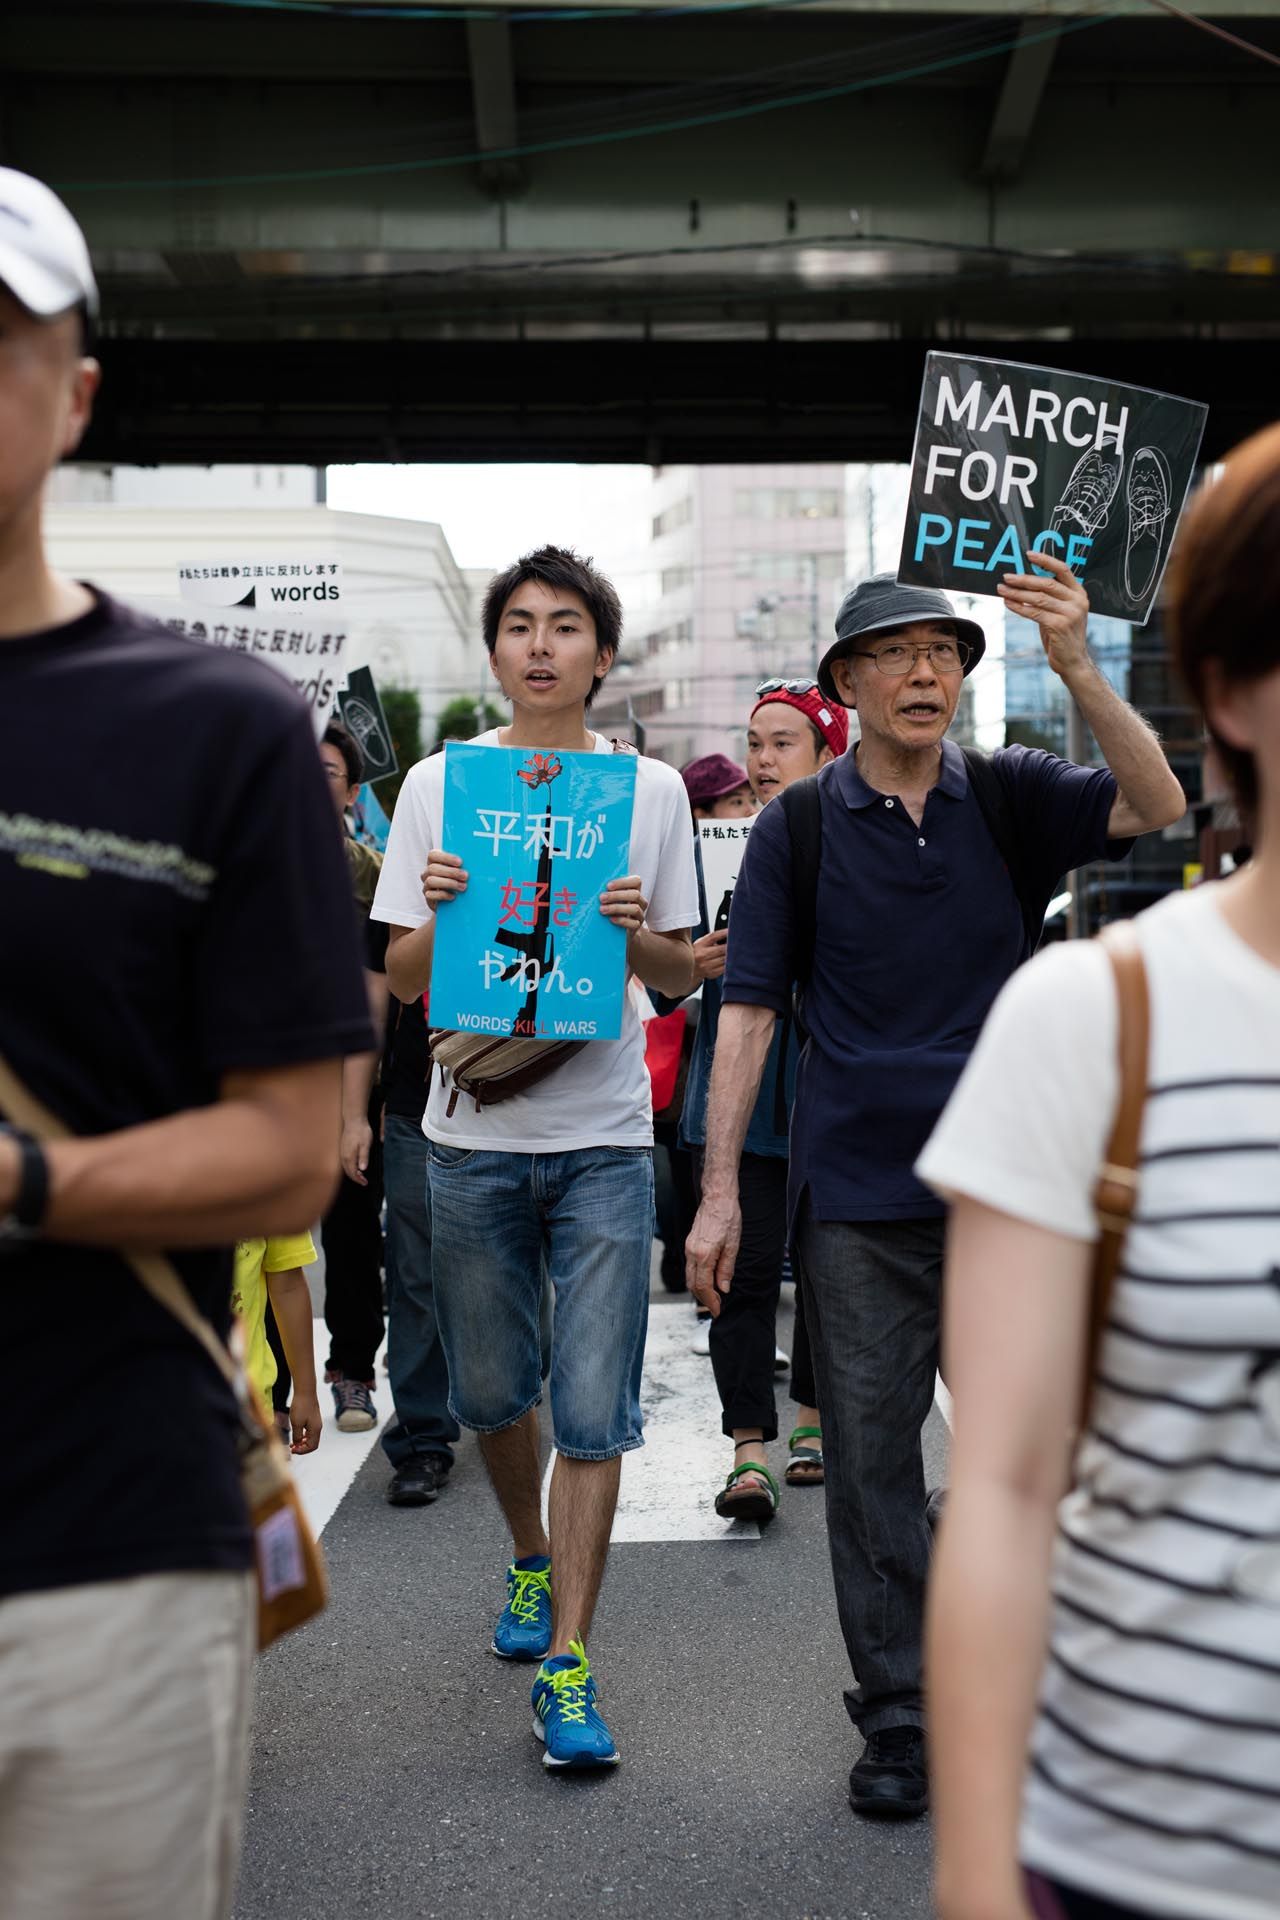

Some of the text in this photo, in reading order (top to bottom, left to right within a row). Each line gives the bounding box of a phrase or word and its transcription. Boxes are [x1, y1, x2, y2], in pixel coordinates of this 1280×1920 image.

[933, 375, 1129, 456] MARCH
[923, 444, 1039, 509] FOR
[270, 581, 340, 602] words
[472, 808, 607, 861] 平和が
[497, 877, 578, 927] 好き
[478, 949, 594, 996] やねん。
[456, 1012, 598, 1035] WORDS KILL WARS
